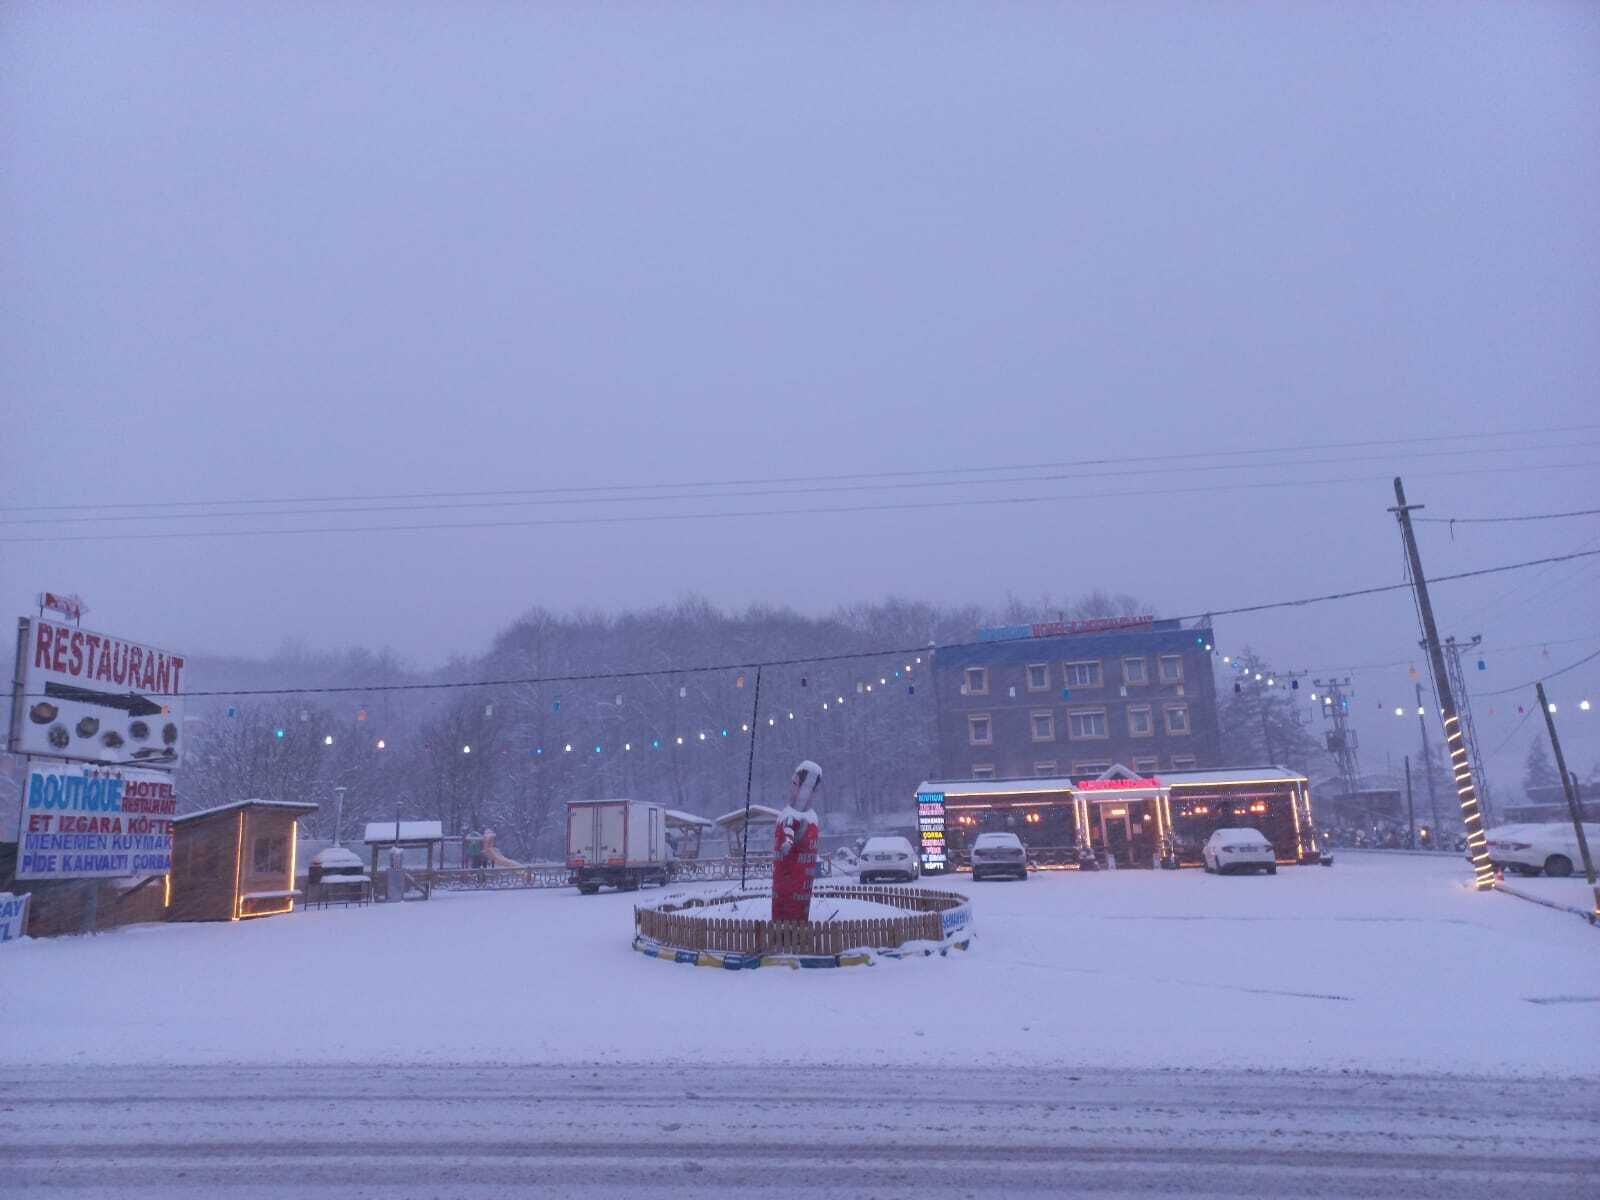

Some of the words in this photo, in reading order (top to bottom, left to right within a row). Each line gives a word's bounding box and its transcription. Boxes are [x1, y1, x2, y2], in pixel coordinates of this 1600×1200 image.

[35, 623, 184, 695] RESTAURANT
[124, 780, 176, 798] HOTEL
[28, 814, 53, 833] ET
[58, 815, 122, 834] IZGARA
[25, 834, 109, 850] MENEMEN
[112, 834, 173, 850] KUYMAK
[61, 853, 129, 873] KAHVALTI
